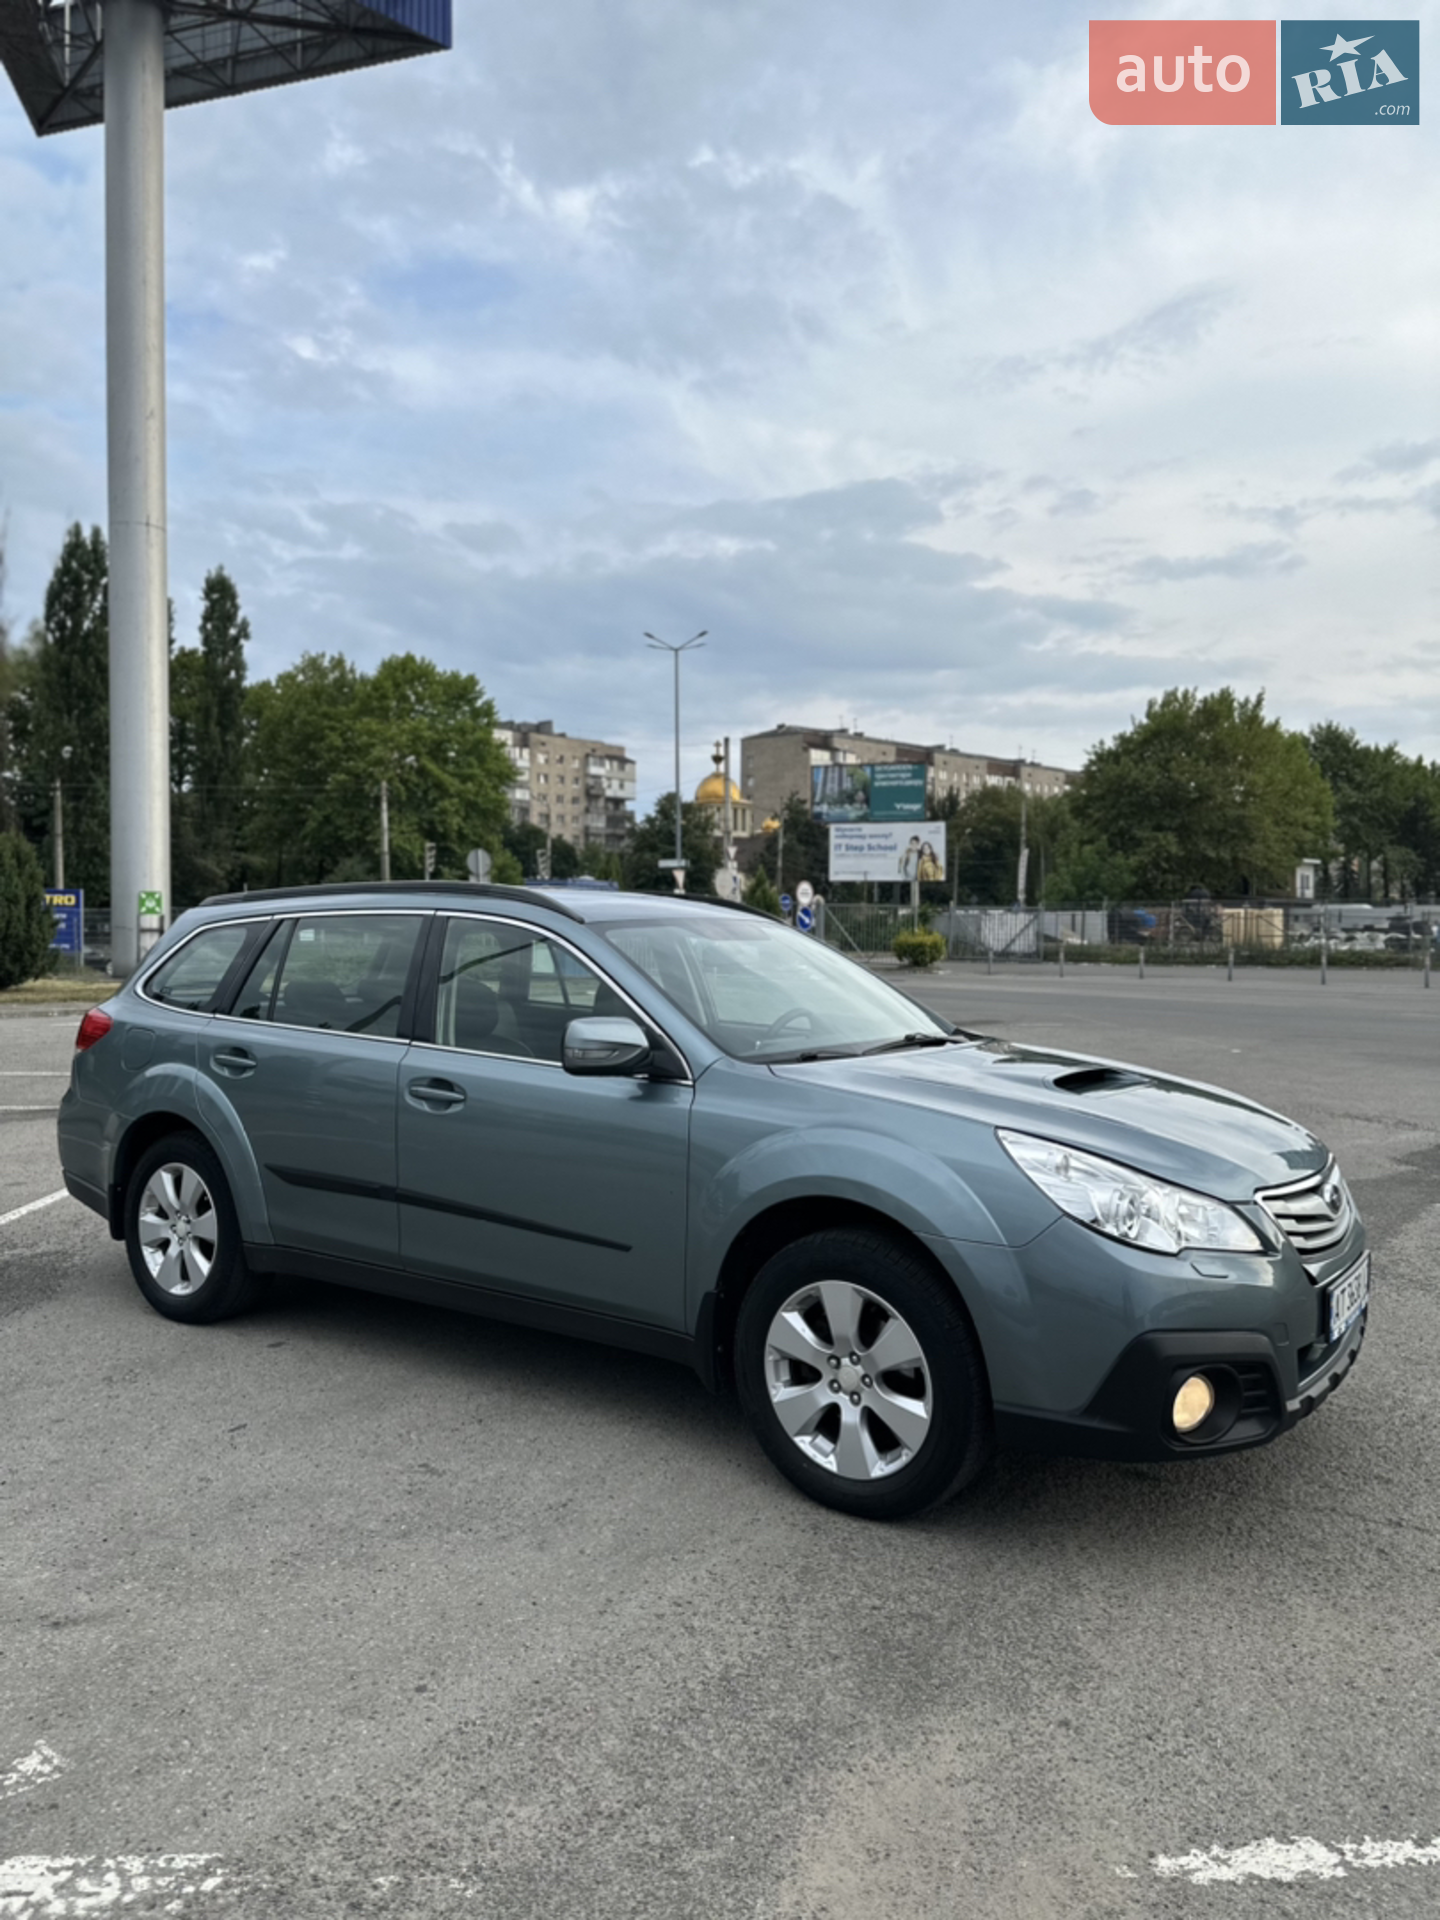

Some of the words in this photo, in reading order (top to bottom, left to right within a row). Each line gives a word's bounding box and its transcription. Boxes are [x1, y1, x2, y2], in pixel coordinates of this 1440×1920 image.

[834, 843, 842, 851] IT
[845, 843, 864, 853] Step
[867, 843, 897, 852] School
[45, 894, 76, 906] TRO
